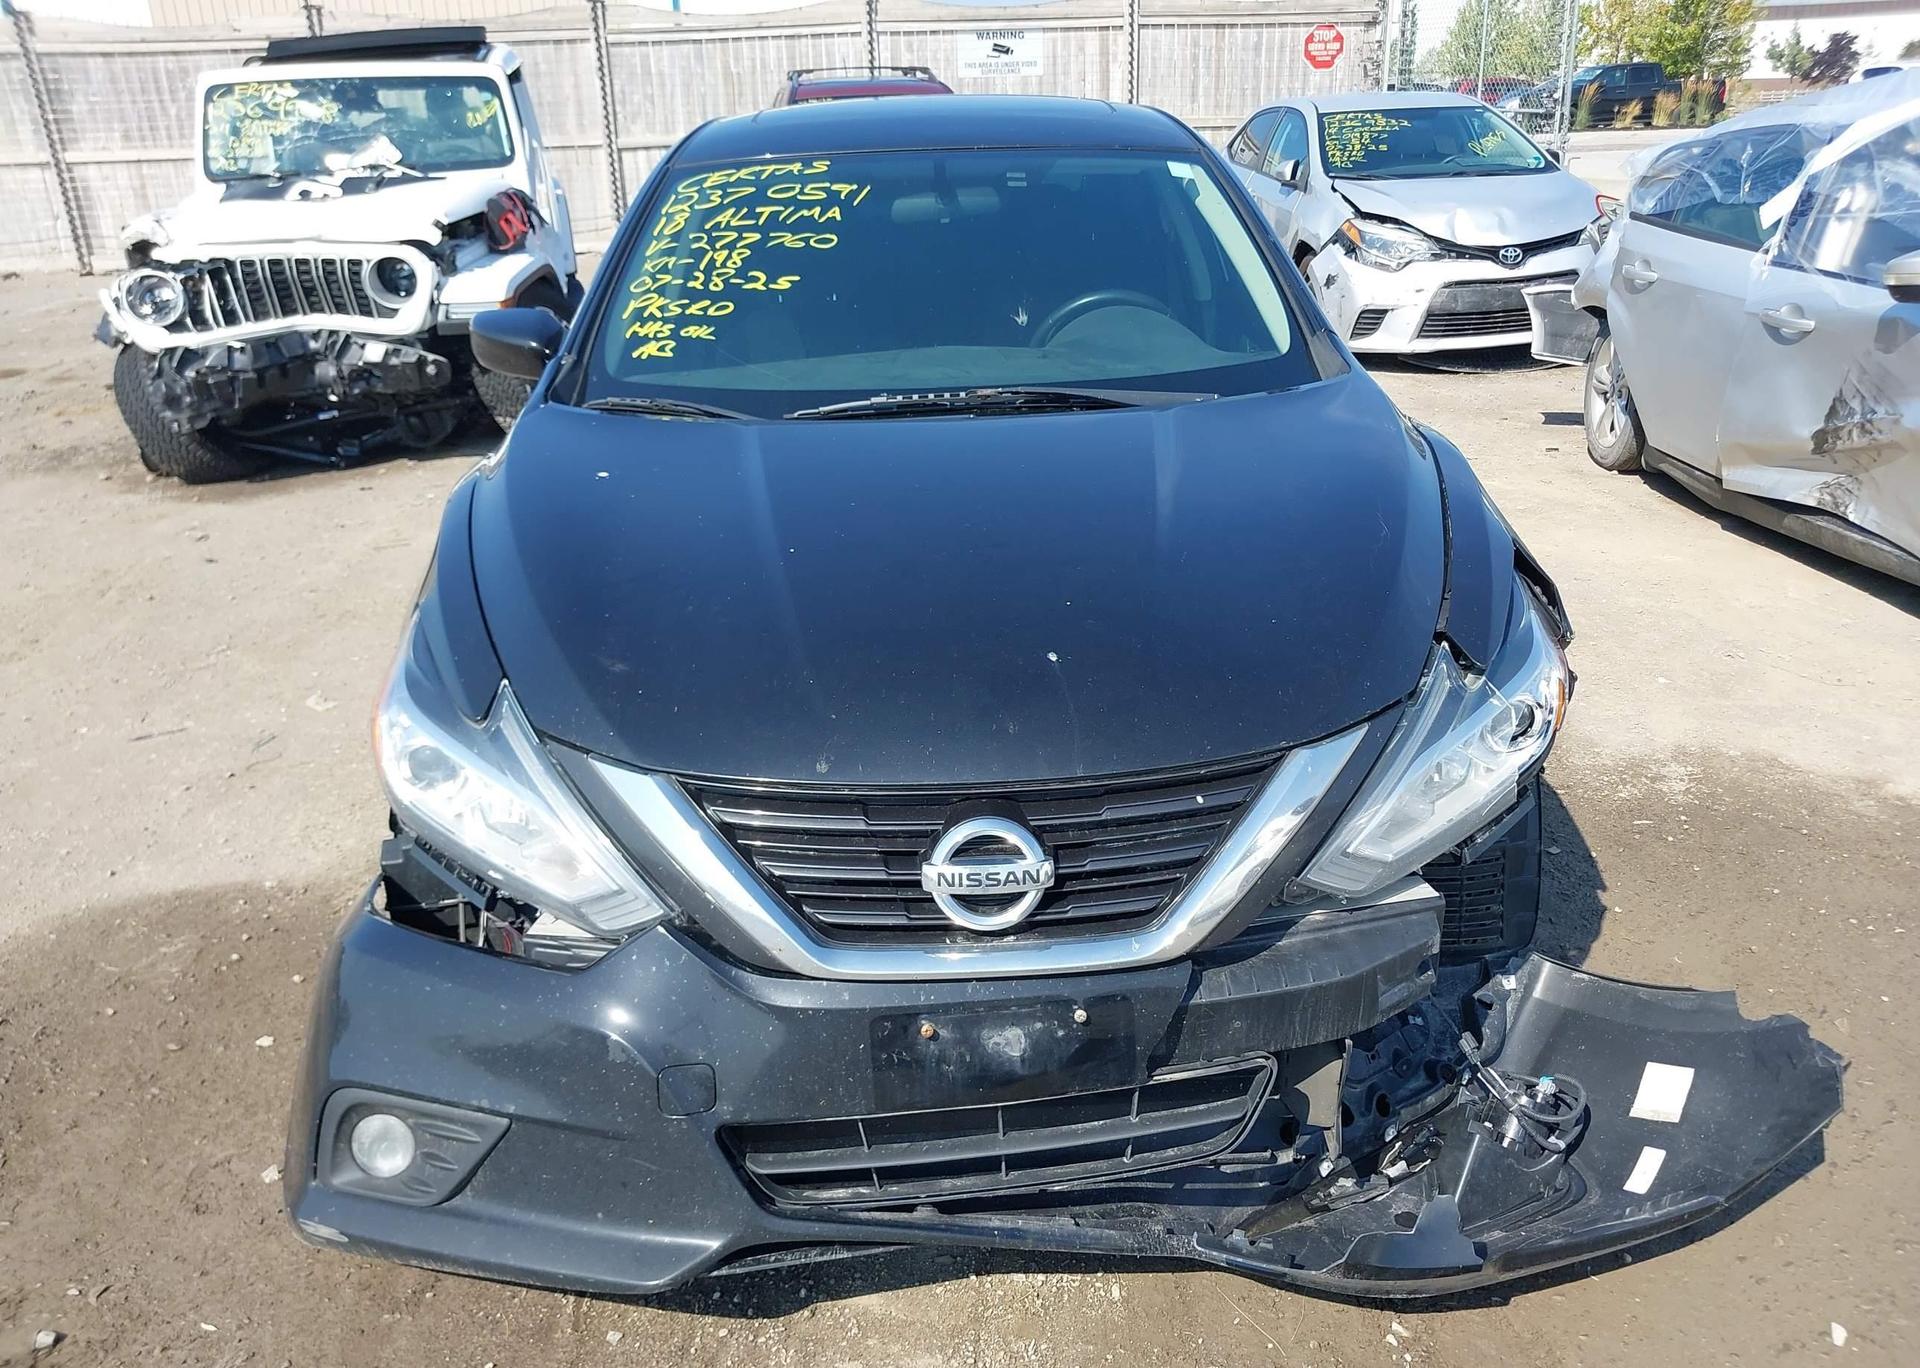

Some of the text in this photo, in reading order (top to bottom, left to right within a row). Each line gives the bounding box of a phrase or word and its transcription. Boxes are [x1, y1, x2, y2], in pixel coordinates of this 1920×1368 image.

[976, 31, 1025, 40] WARNING
[1313, 30, 1337, 41] STOP
[1323, 112, 1382, 121] CERTAS
[677, 160, 831, 193] CERTAS
[661, 182, 871, 215] 1237 0591
[653, 206, 842, 236] 18 ALTIMA
[629, 268, 801, 293] 07-28-25
[937, 868, 1041, 888] NISSAN
